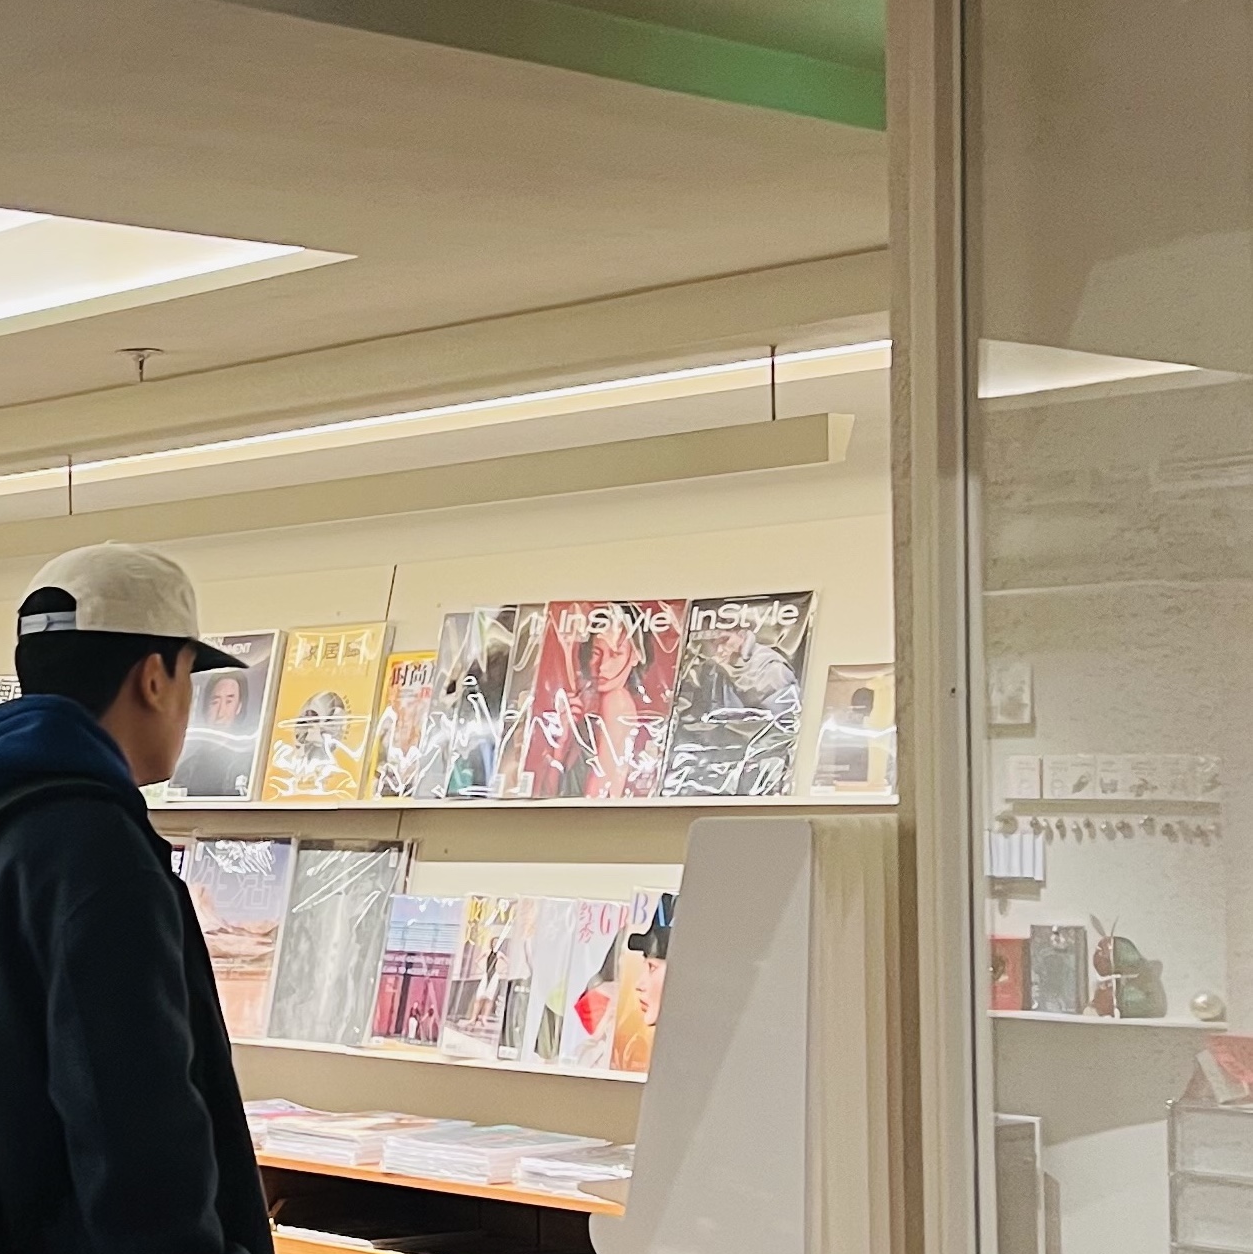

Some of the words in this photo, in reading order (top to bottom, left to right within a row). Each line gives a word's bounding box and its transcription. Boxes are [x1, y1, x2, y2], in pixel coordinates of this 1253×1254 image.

[559, 606, 674, 640] InStyle
[690, 600, 800, 634] InStyle
[391, 663, 435, 687] 时尚
